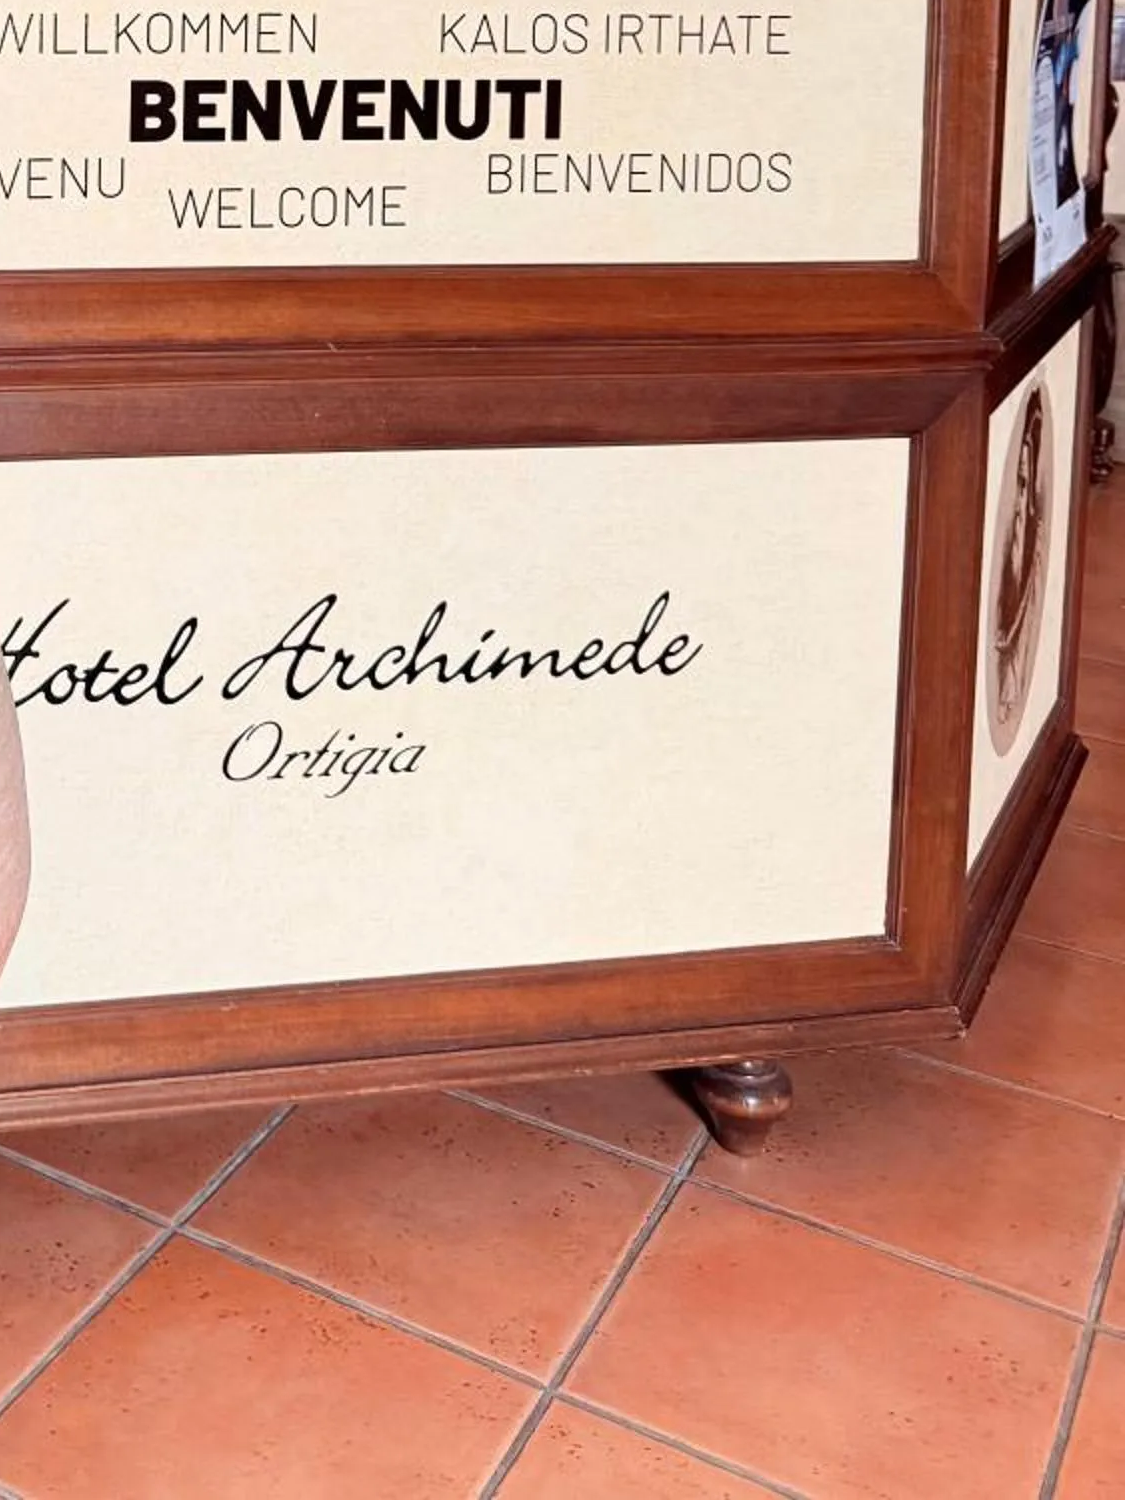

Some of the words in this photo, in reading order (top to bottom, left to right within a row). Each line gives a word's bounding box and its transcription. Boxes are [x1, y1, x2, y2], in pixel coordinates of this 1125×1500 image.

[439, 13, 588, 55] KALOS
[604, 13, 792, 55] IRTHATE
[130, 79, 562, 143] BENVENUTI
[487, 152, 792, 195] BIENVENIDOS
[169, 185, 407, 229] WELCOME
[1, 598, 204, 707] Hotel
[222, 589, 704, 701] Archimede
[222, 721, 427, 798] Ortigia
